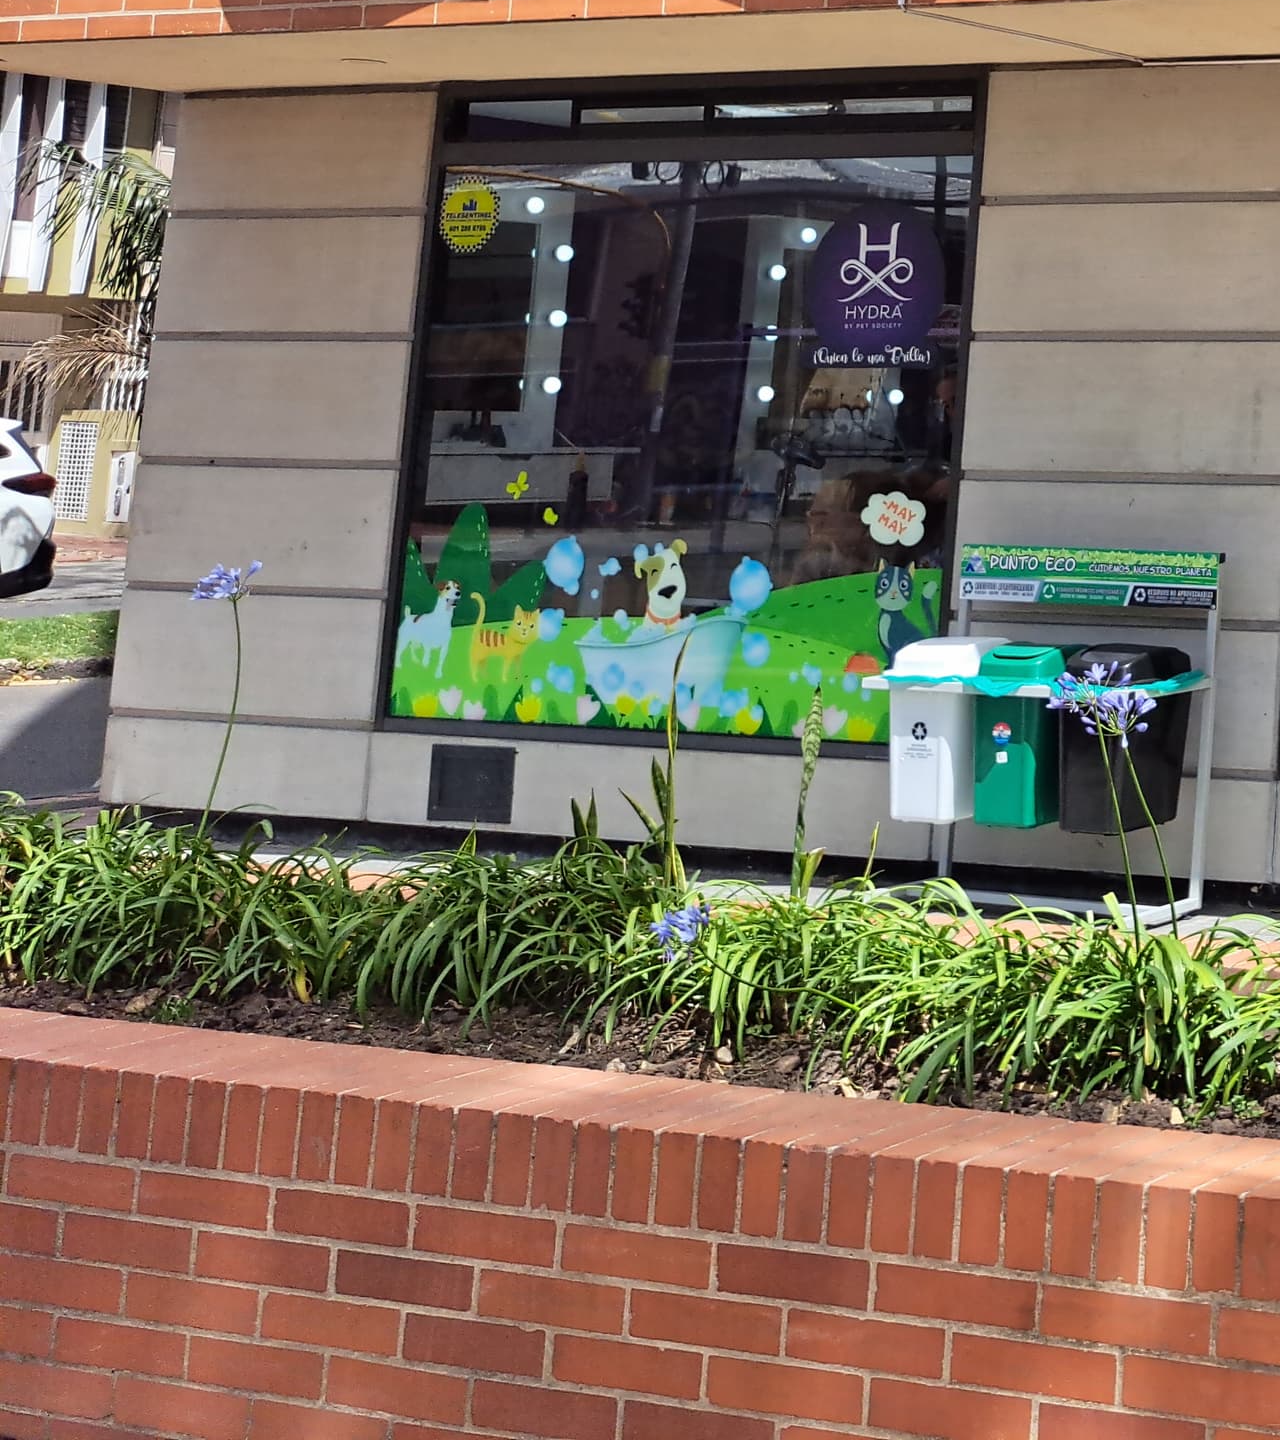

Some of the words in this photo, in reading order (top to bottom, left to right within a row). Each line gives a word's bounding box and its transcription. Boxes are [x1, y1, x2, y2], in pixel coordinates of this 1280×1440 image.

[845, 305, 903, 320] HYDRA
[990, 555, 1039, 571] PUNTO
[1045, 556, 1077, 572] ECO
[1088, 562, 1130, 573] CUIDEMOS
[1133, 565, 1172, 575] NUESTRO
[1175, 567, 1212, 577] PLANETA
